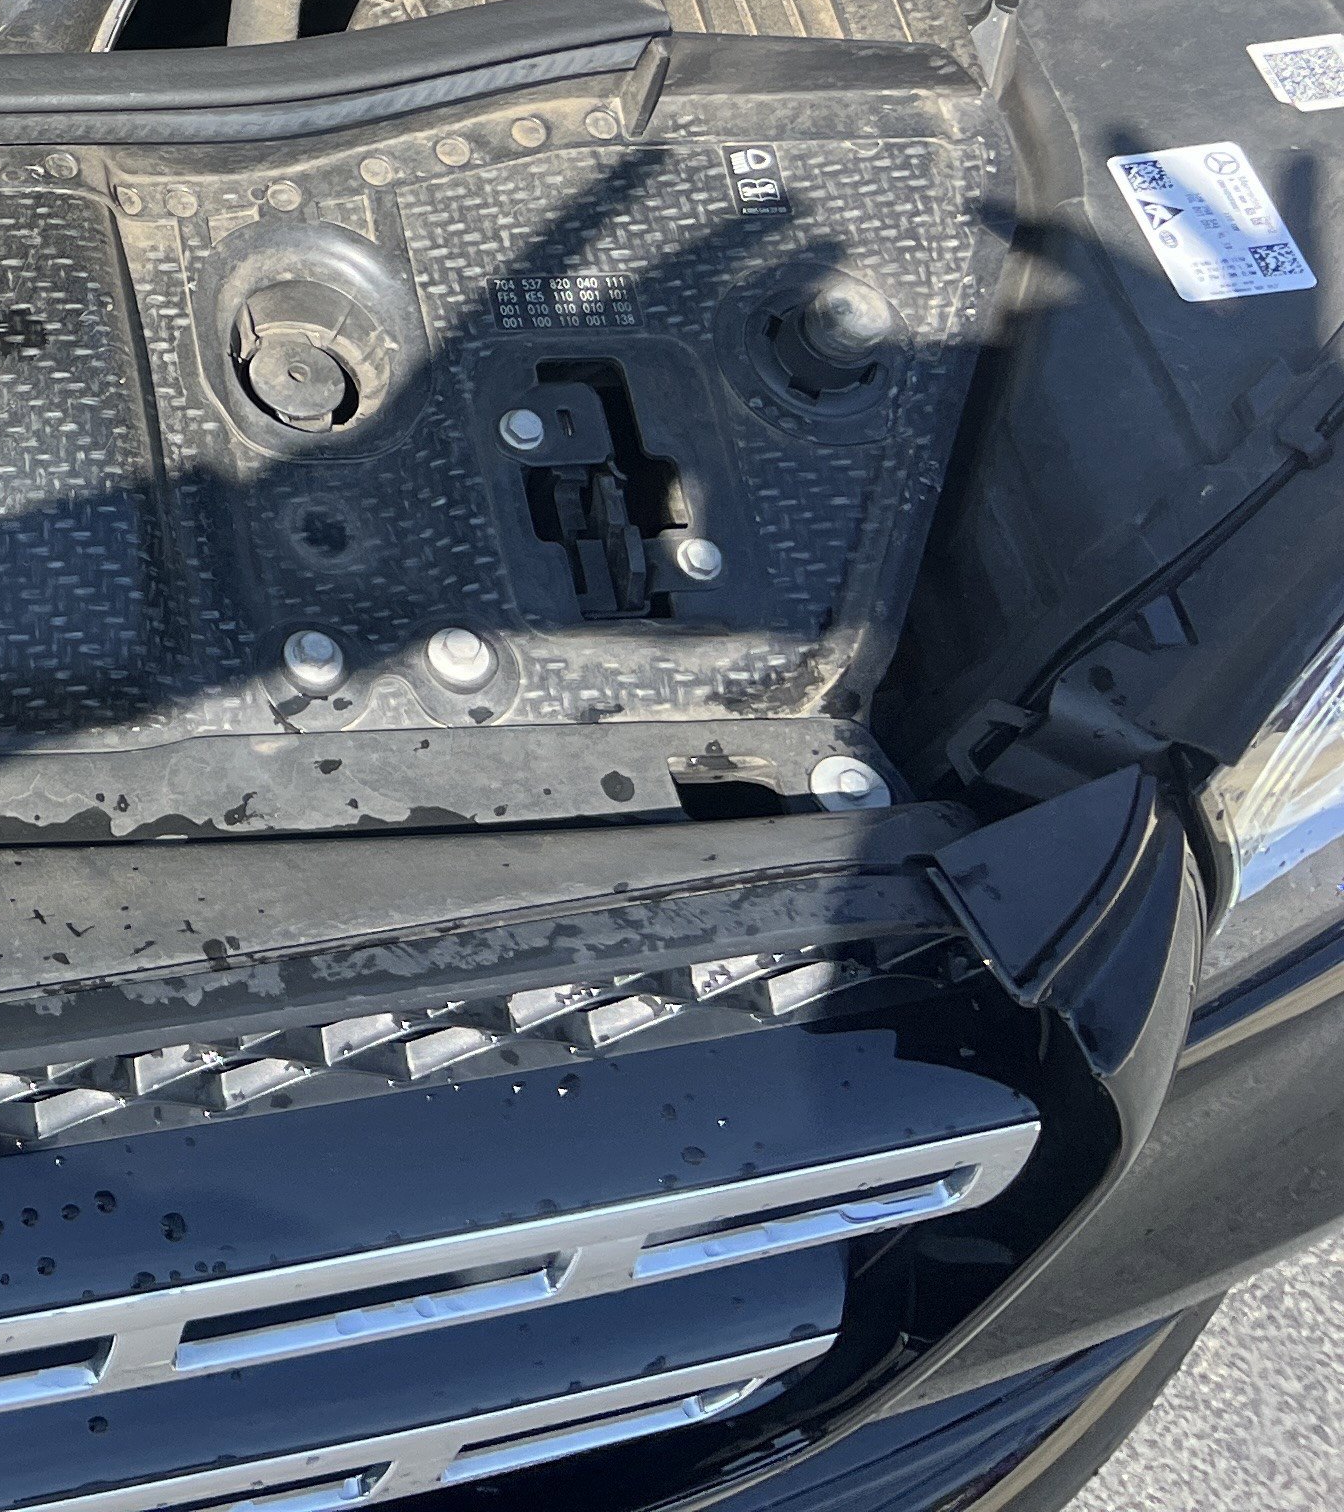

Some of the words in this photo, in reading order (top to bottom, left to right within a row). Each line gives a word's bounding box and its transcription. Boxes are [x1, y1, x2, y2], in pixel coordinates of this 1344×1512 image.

[494, 279, 515, 290] 704
[521, 279, 542, 290] 537
[549, 278, 571, 290] 820
[576, 277, 598, 288] 040
[605, 276, 625, 288] 111
[553, 290, 574, 302] 110
[579, 290, 600, 301] 001
[608, 289, 628, 300] 101
[499, 305, 521, 316] 001
[527, 304, 549, 315] 010
[554, 303, 576, 314] 010
[582, 302, 604, 313] 010
[611, 301, 632, 312] 100
[502, 317, 524, 328] 001
[531, 316, 552, 327] 100
[559, 316, 580, 327] 110
[585, 315, 607, 326] 001
[615, 314, 636, 325] 138
